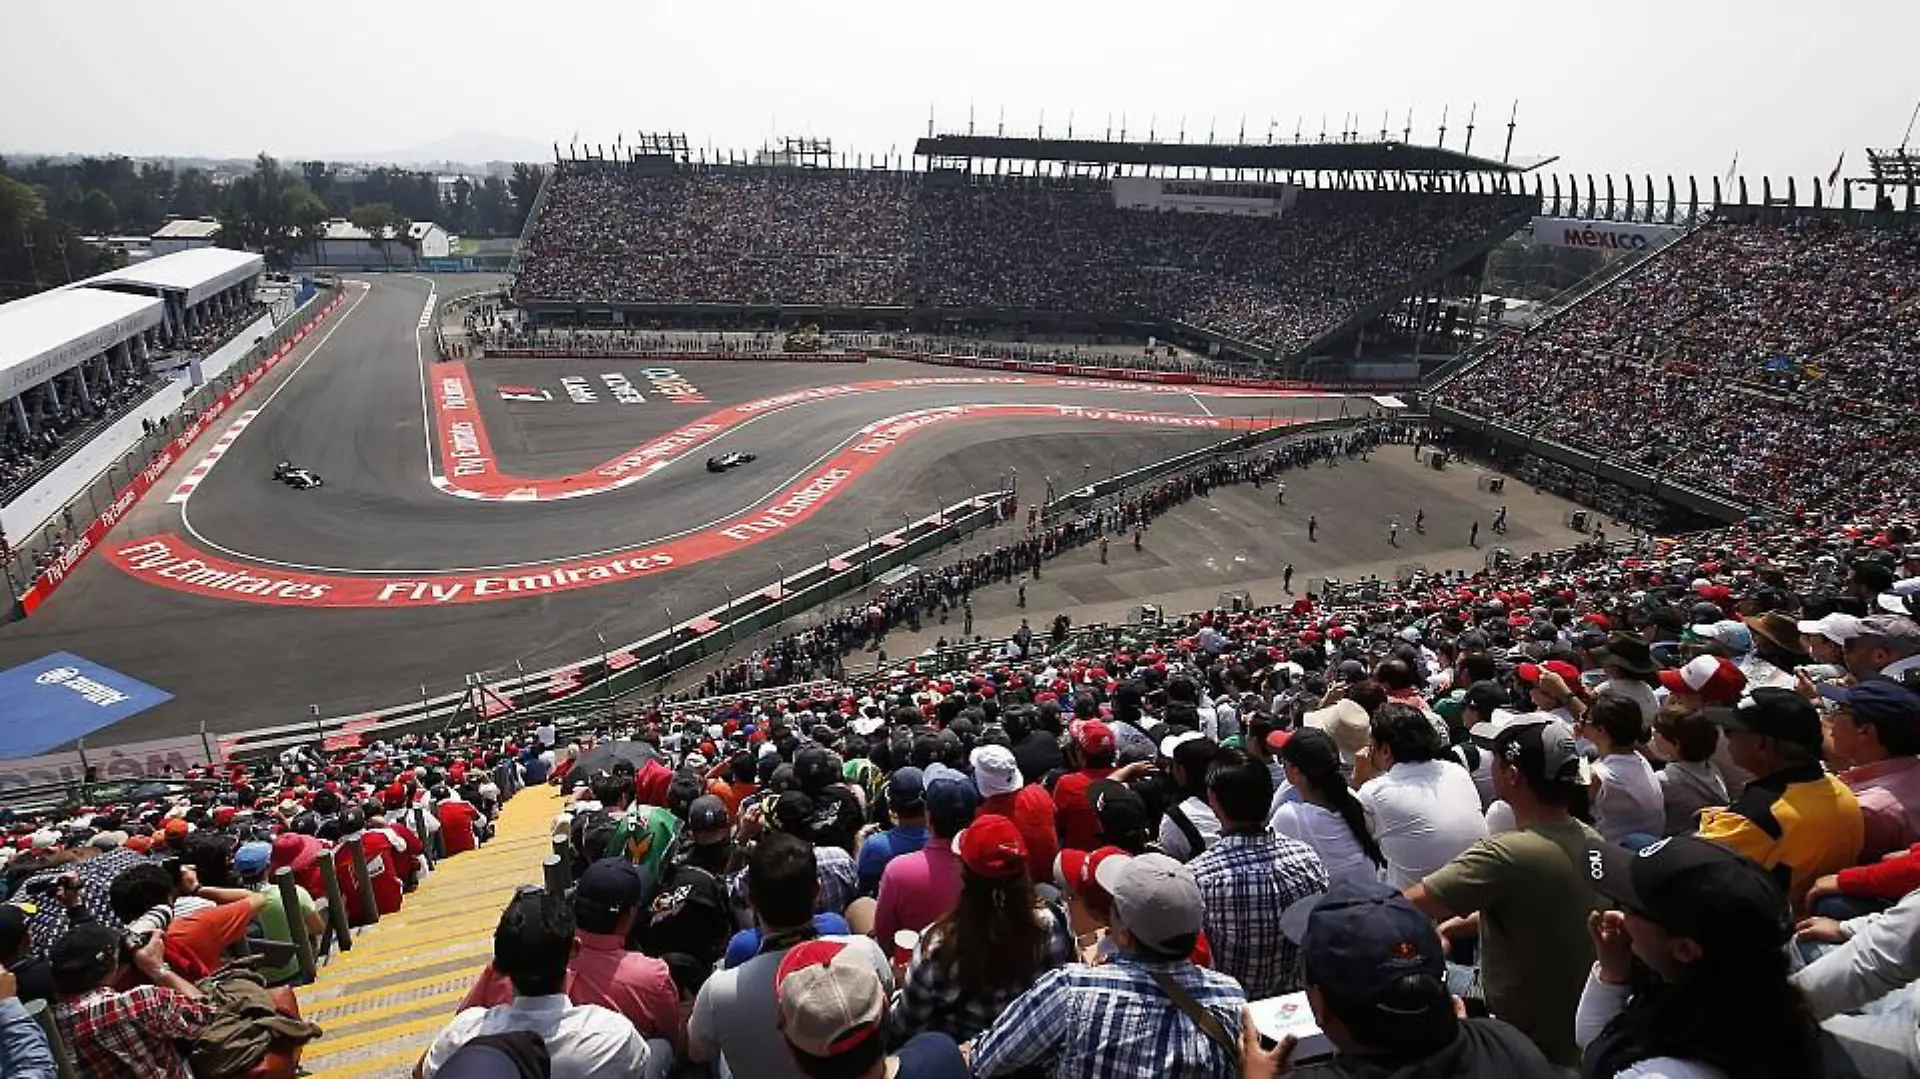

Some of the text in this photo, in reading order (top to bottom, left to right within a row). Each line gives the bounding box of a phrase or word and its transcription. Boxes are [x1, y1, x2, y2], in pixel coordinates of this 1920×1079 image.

[718, 468, 852, 541] Fly Emirates
[117, 540, 333, 600] Fly Emirates
[378, 552, 674, 601] Fly Emirates
